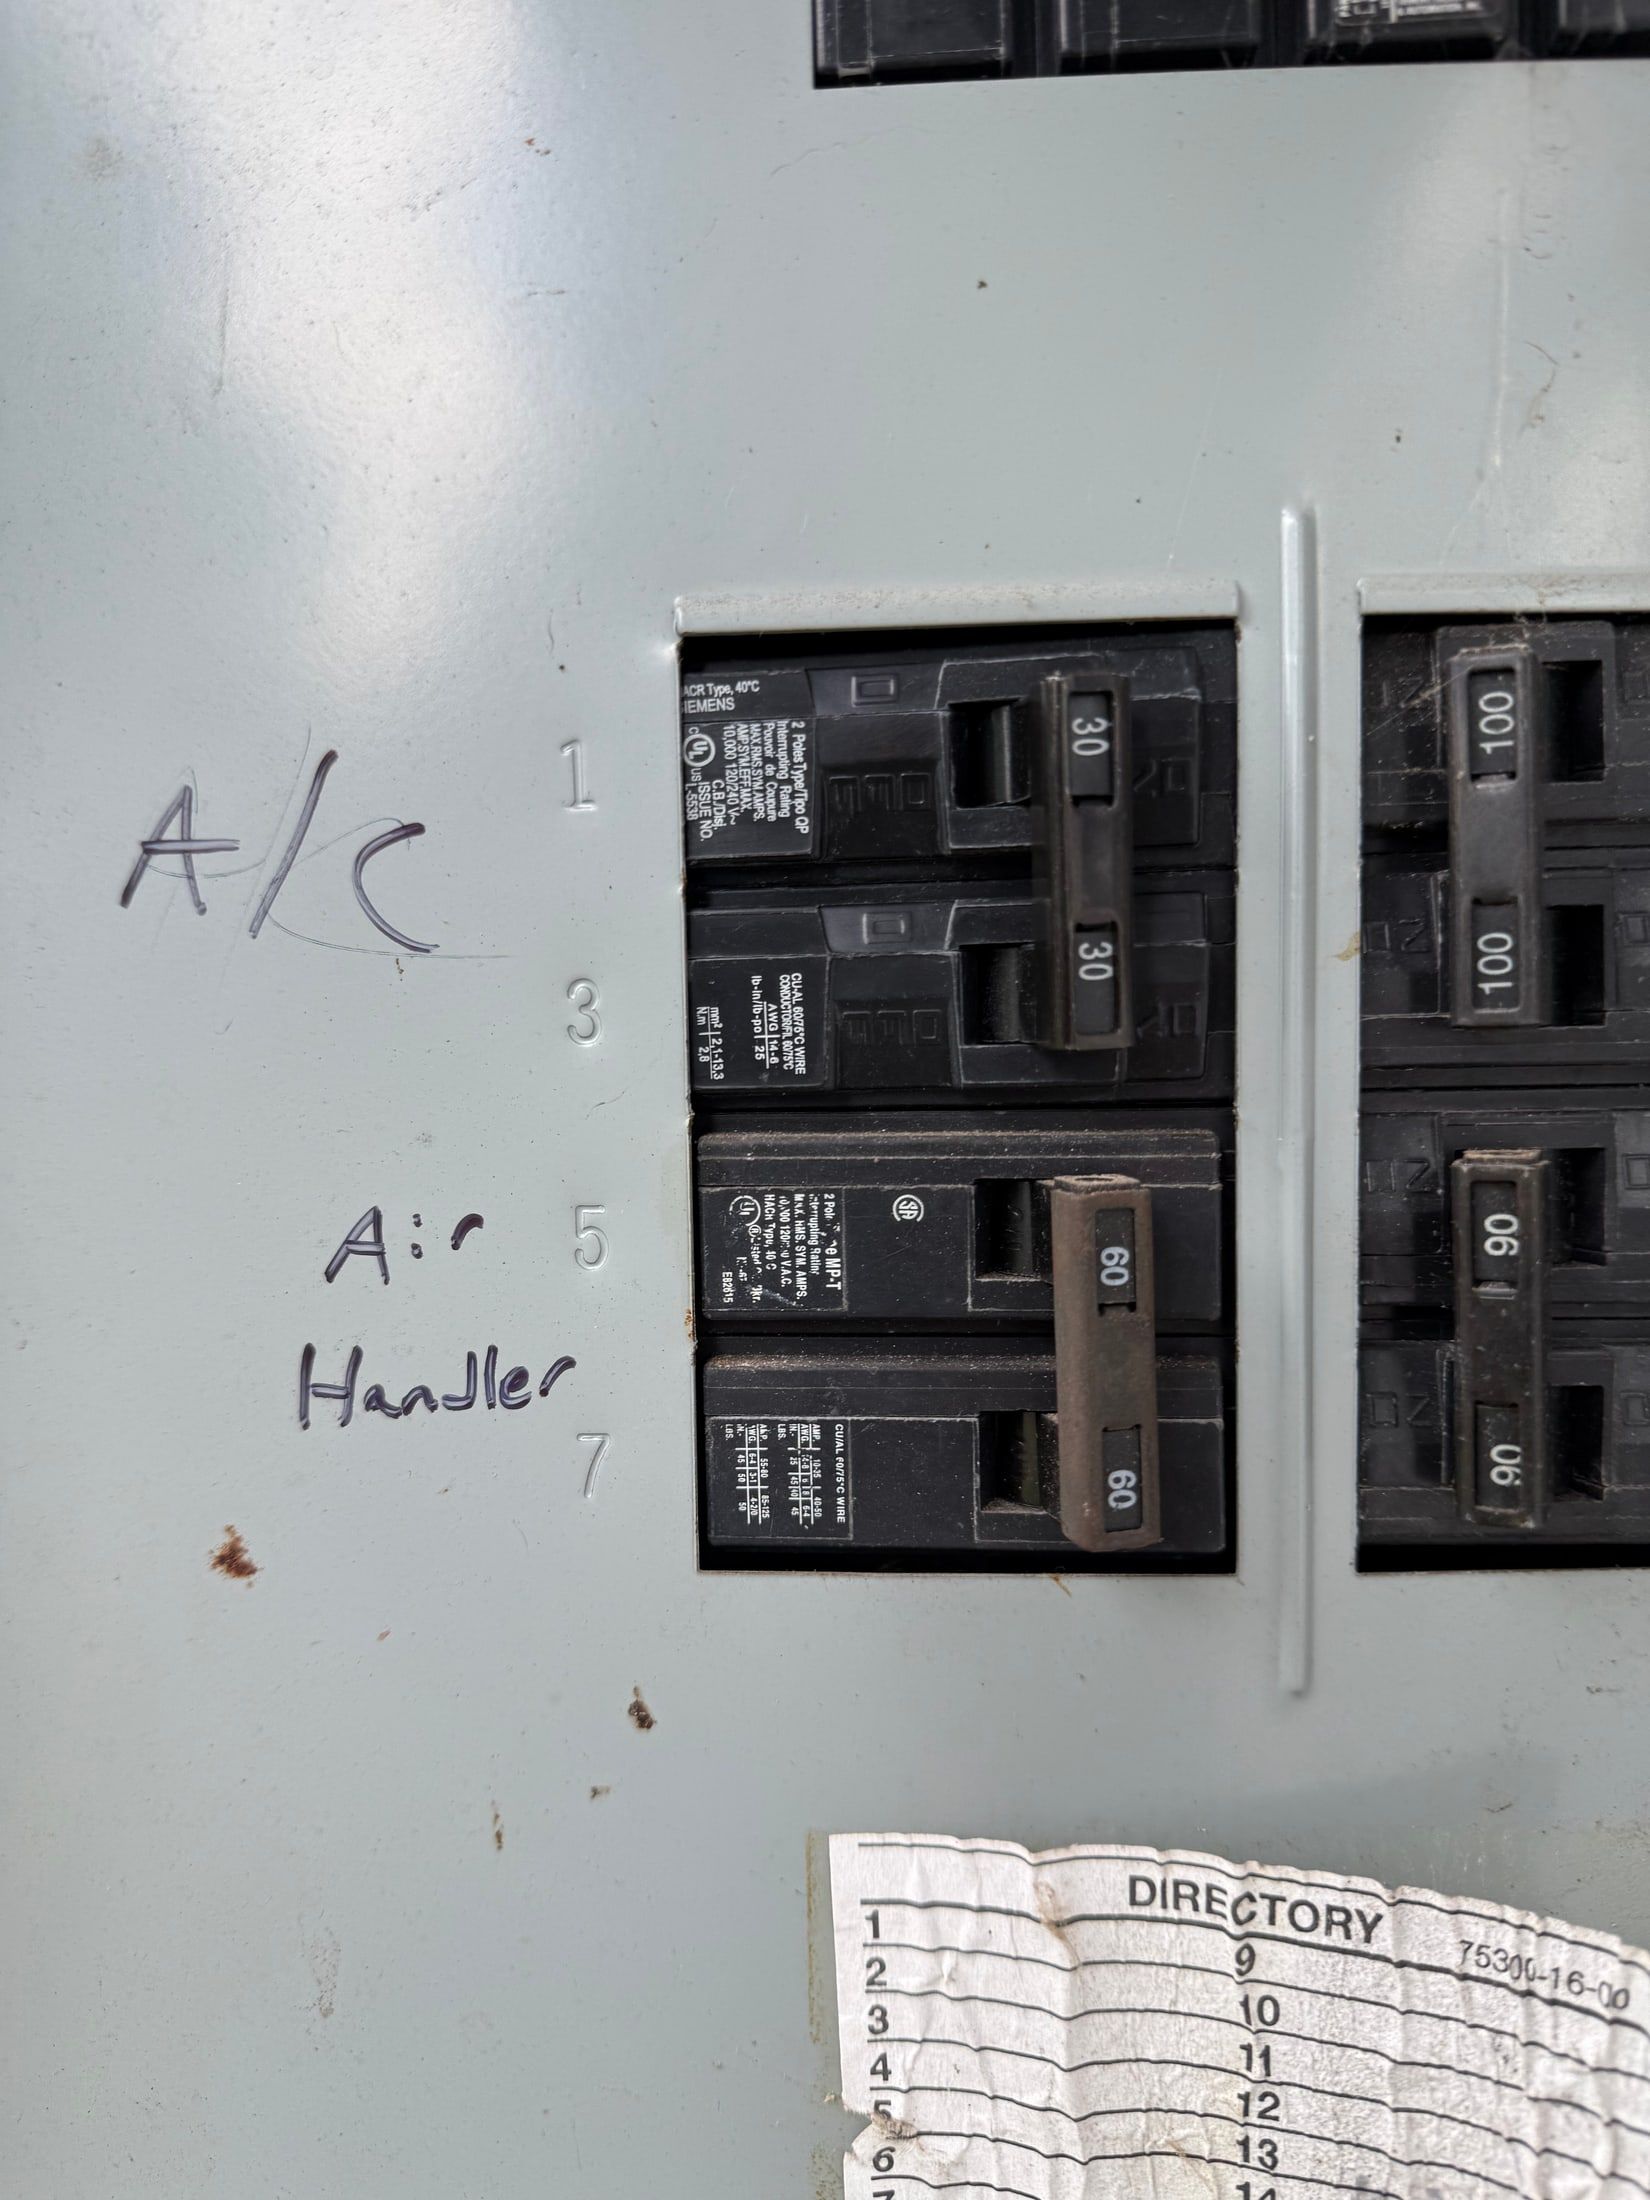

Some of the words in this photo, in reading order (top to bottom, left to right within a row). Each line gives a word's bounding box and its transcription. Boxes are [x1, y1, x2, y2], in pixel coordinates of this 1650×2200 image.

[706, 682, 734, 697] Type,
[735, 680, 760, 693] 40°C
[681, 697, 735, 713] IEMENS
[1070, 717, 1111, 756] 30
[1477, 690, 1516, 756] 100
[722, 725, 736, 760] 10,000
[764, 723, 775, 758] Pouvoir
[776, 720, 790, 779] Interrupting
[794, 735, 807, 763] Poles
[560, 739, 597, 811] 1
[724, 765, 738, 804] 120/240
[766, 764, 776, 776] de
[698, 782, 711, 817] ISSUE
[764, 782, 776, 822] Coupure
[778, 786, 791, 817] Rating
[699, 820, 712, 842] NO.
[794, 817, 809, 834] QP
[121, 749, 441, 953] A/C
[1077, 942, 1114, 981] 30
[1477, 931, 1515, 996] 100
[792, 973, 802, 1004] CU-AL
[566, 977, 601, 1047] 3
[768, 1004, 778, 1032] AWG
[780, 975, 790, 1040] CONDUCTOR/FIL
[699, 1047, 709, 1062] 2,8
[755, 1046, 765, 1060] 25
[795, 1047, 805, 1074] WIRE
[574, 1204, 609, 1270] 5
[1483, 1213, 1519, 1256] 90
[795, 1246, 807, 1268] SYM.
[1100, 1246, 1130, 1287] 60
[781, 1261, 793, 1288] V.A.C.
[796, 1270, 808, 1300] AMPS.
[825, 1258, 841, 1290] MP-T
[725, 1424, 733, 1440] LBS.
[778, 1424, 786, 1440] LBS.
[835, 1424, 844, 1454] CU/AL
[576, 1432, 610, 1498] 7
[738, 1454, 745, 1463] 45
[1489, 1442, 1522, 1486] 90
[738, 1474, 745, 1482] 50
[791, 1476, 798, 1484] 45
[791, 1489, 799, 1497] 40
[1107, 1469, 1137, 1510] 60
[739, 1502, 746, 1511] 50
[750, 1497, 758, 1515] 4-2/0
[792, 1507, 799, 1515] 45
[803, 1506, 811, 1517] 6-4
[837, 1497, 845, 1523] WIRE
[865, 1909, 881, 1939] 1
[1128, 1875, 1383, 1943] DIRECTORY
[865, 1956, 887, 1987] 2
[1234, 1943, 1256, 1977] 9
[1458, 1939, 1631, 2010] 75300-16-00
[867, 2004, 889, 2035] 3
[1239, 1994, 1281, 2027] 10
[870, 2052, 892, 2081] 4
[1239, 2043, 1272, 2078] 11
[1237, 2091, 1281, 2121] 12
[872, 2147, 895, 2173] 6
[1236, 2134, 1279, 2171] 13
